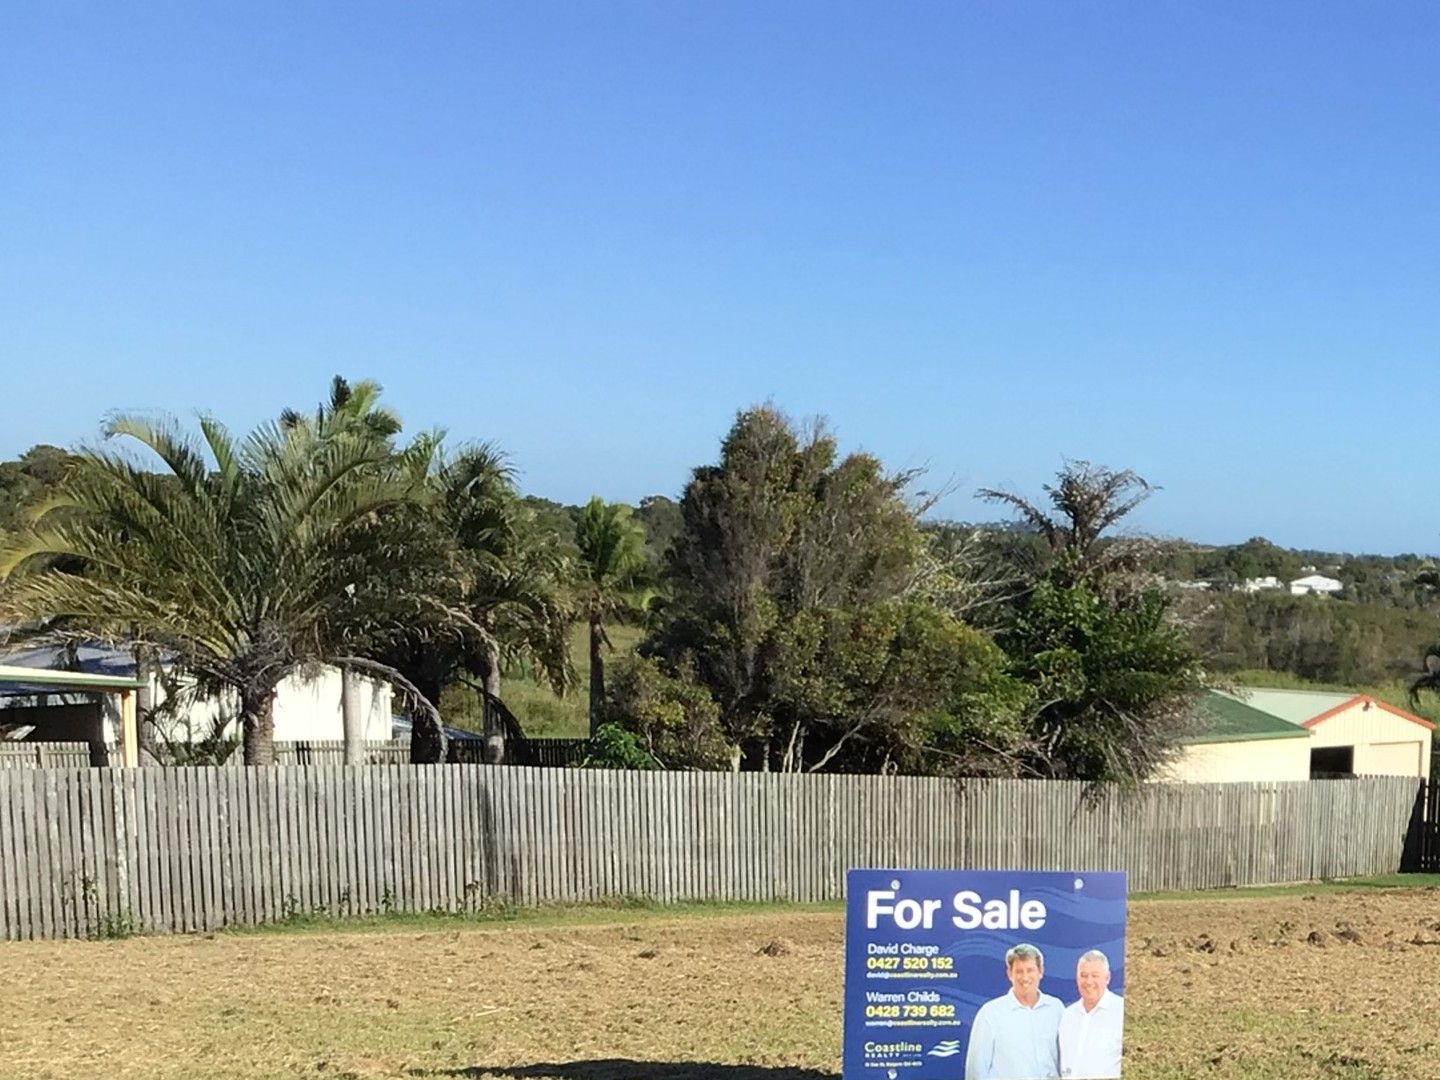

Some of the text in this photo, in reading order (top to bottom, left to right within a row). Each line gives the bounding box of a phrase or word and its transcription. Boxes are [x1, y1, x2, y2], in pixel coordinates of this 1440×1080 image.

[867, 889, 1047, 930] For Sale
[867, 943, 940, 956] David Charge
[867, 957, 954, 969] 0427 520 152
[866, 991, 940, 1002] Warren Childs
[866, 1005, 955, 1017] 0428 739 682
[864, 1041, 922, 1053] Coastline
